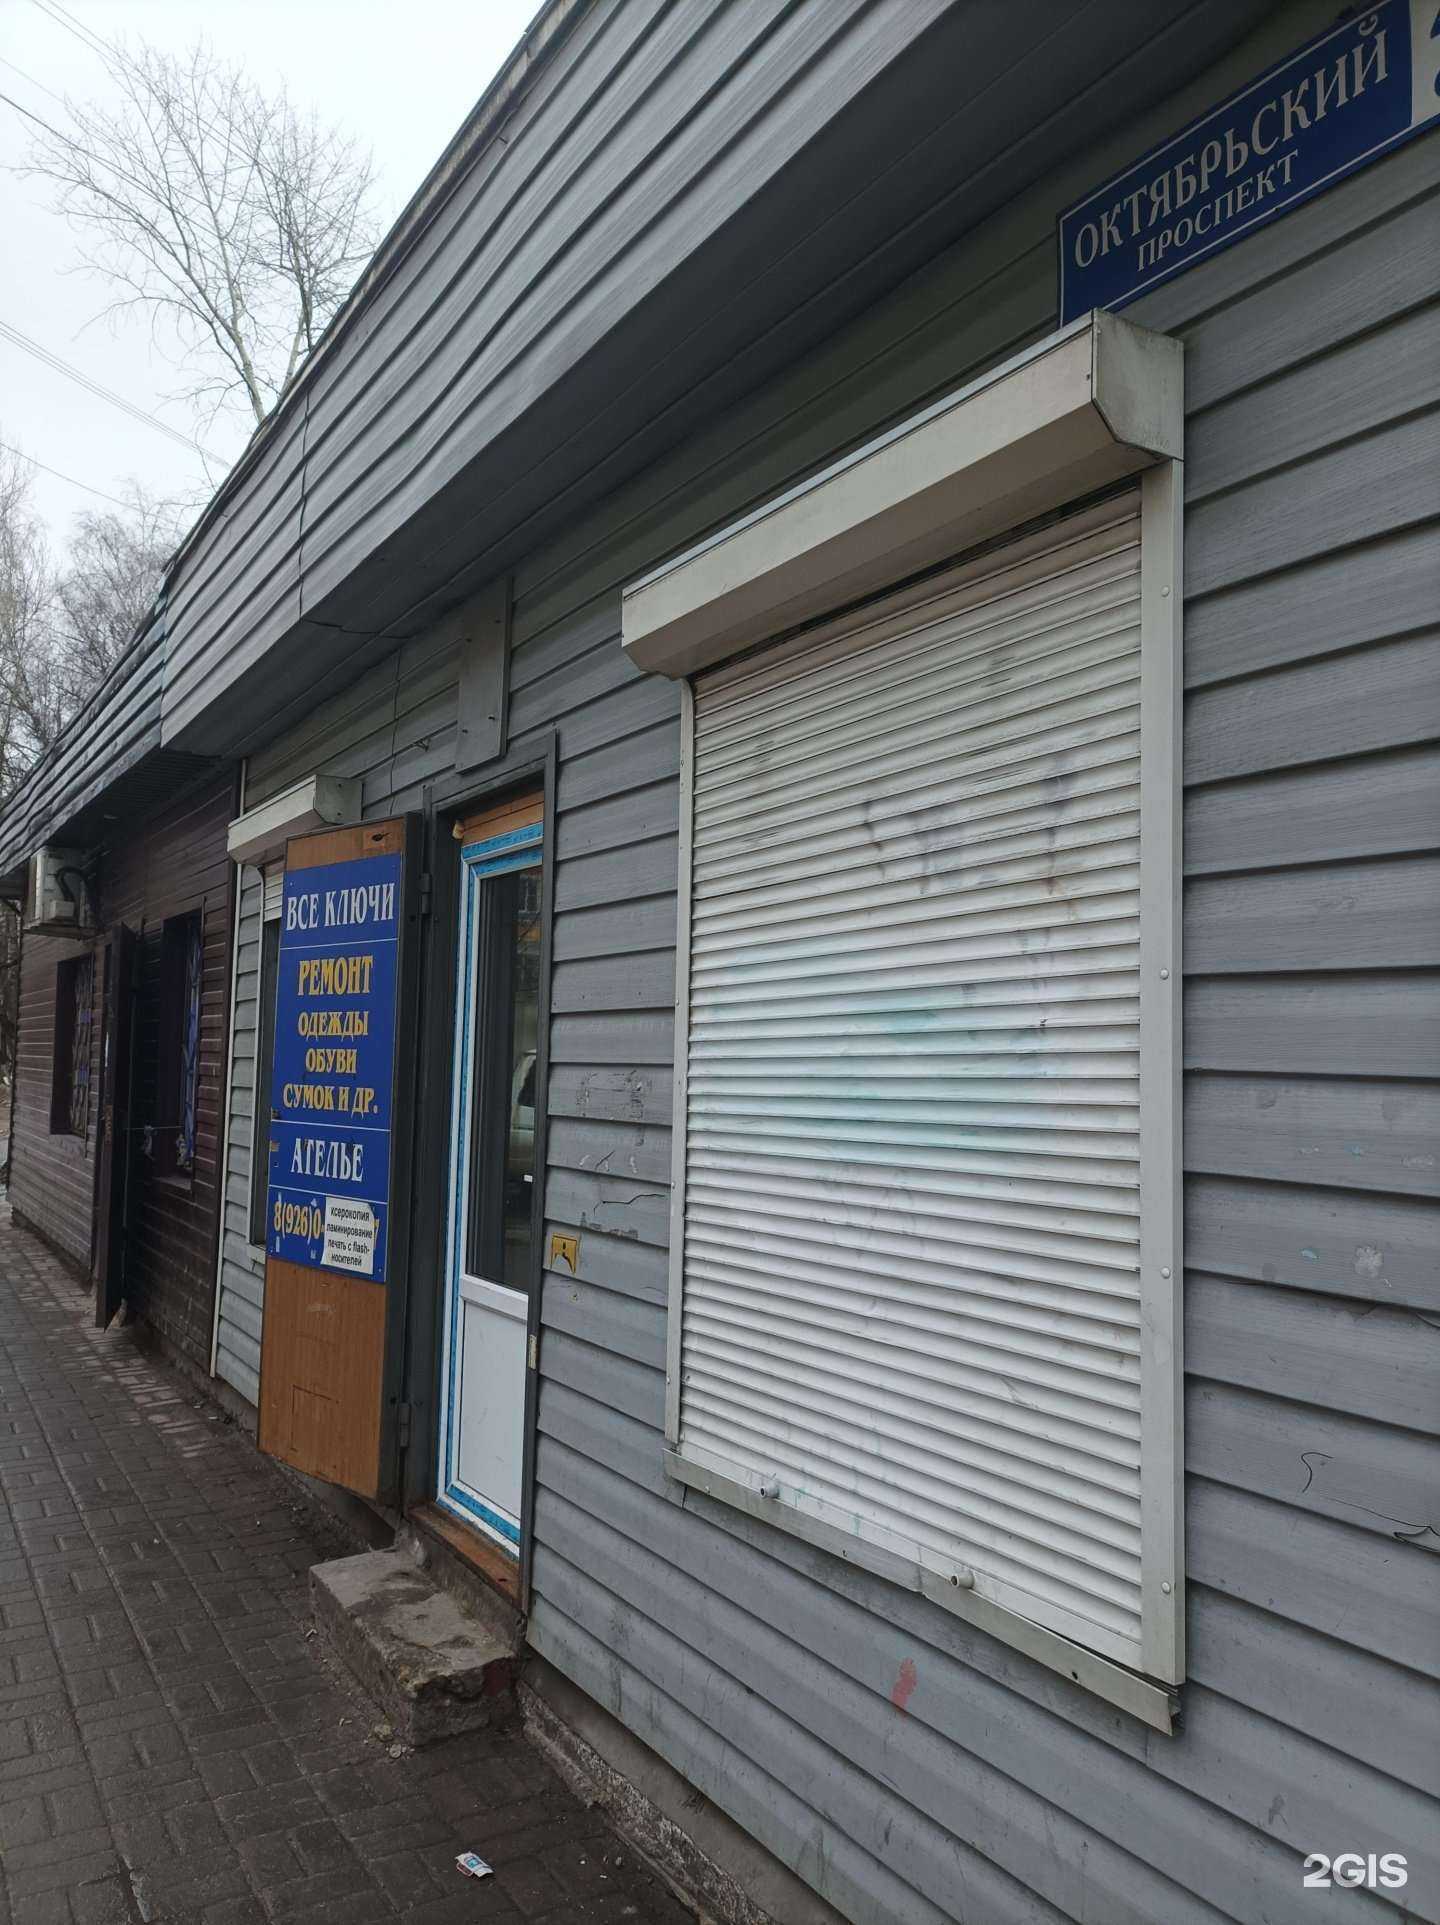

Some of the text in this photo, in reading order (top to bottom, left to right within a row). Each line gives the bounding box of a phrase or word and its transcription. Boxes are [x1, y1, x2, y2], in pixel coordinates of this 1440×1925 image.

[1075, 15, 1388, 268] ОКТЯБРЬСКИЙ
[1137, 149, 1298, 272] ПРОСПЕКТ
[286, 882, 395, 932] ВСЕ КЛЮЧИ
[297, 955, 374, 996] РЕМОНТ
[297, 1010, 369, 1042] ОДЕЖДЫ
[305, 1048, 358, 1074] ОБУВИ
[283, 1084, 378, 1119] СУМОК И ДР.
[290, 1137, 364, 1182] АТЕЛЬЕ
[274, 1201, 325, 1245] 8(926)0
[327, 1224, 373, 1239] ламинирование
[331, 1207, 370, 1222] ксерокопия
[328, 1239, 346, 1251] печать
[331, 1253, 362, 1267] носителей
